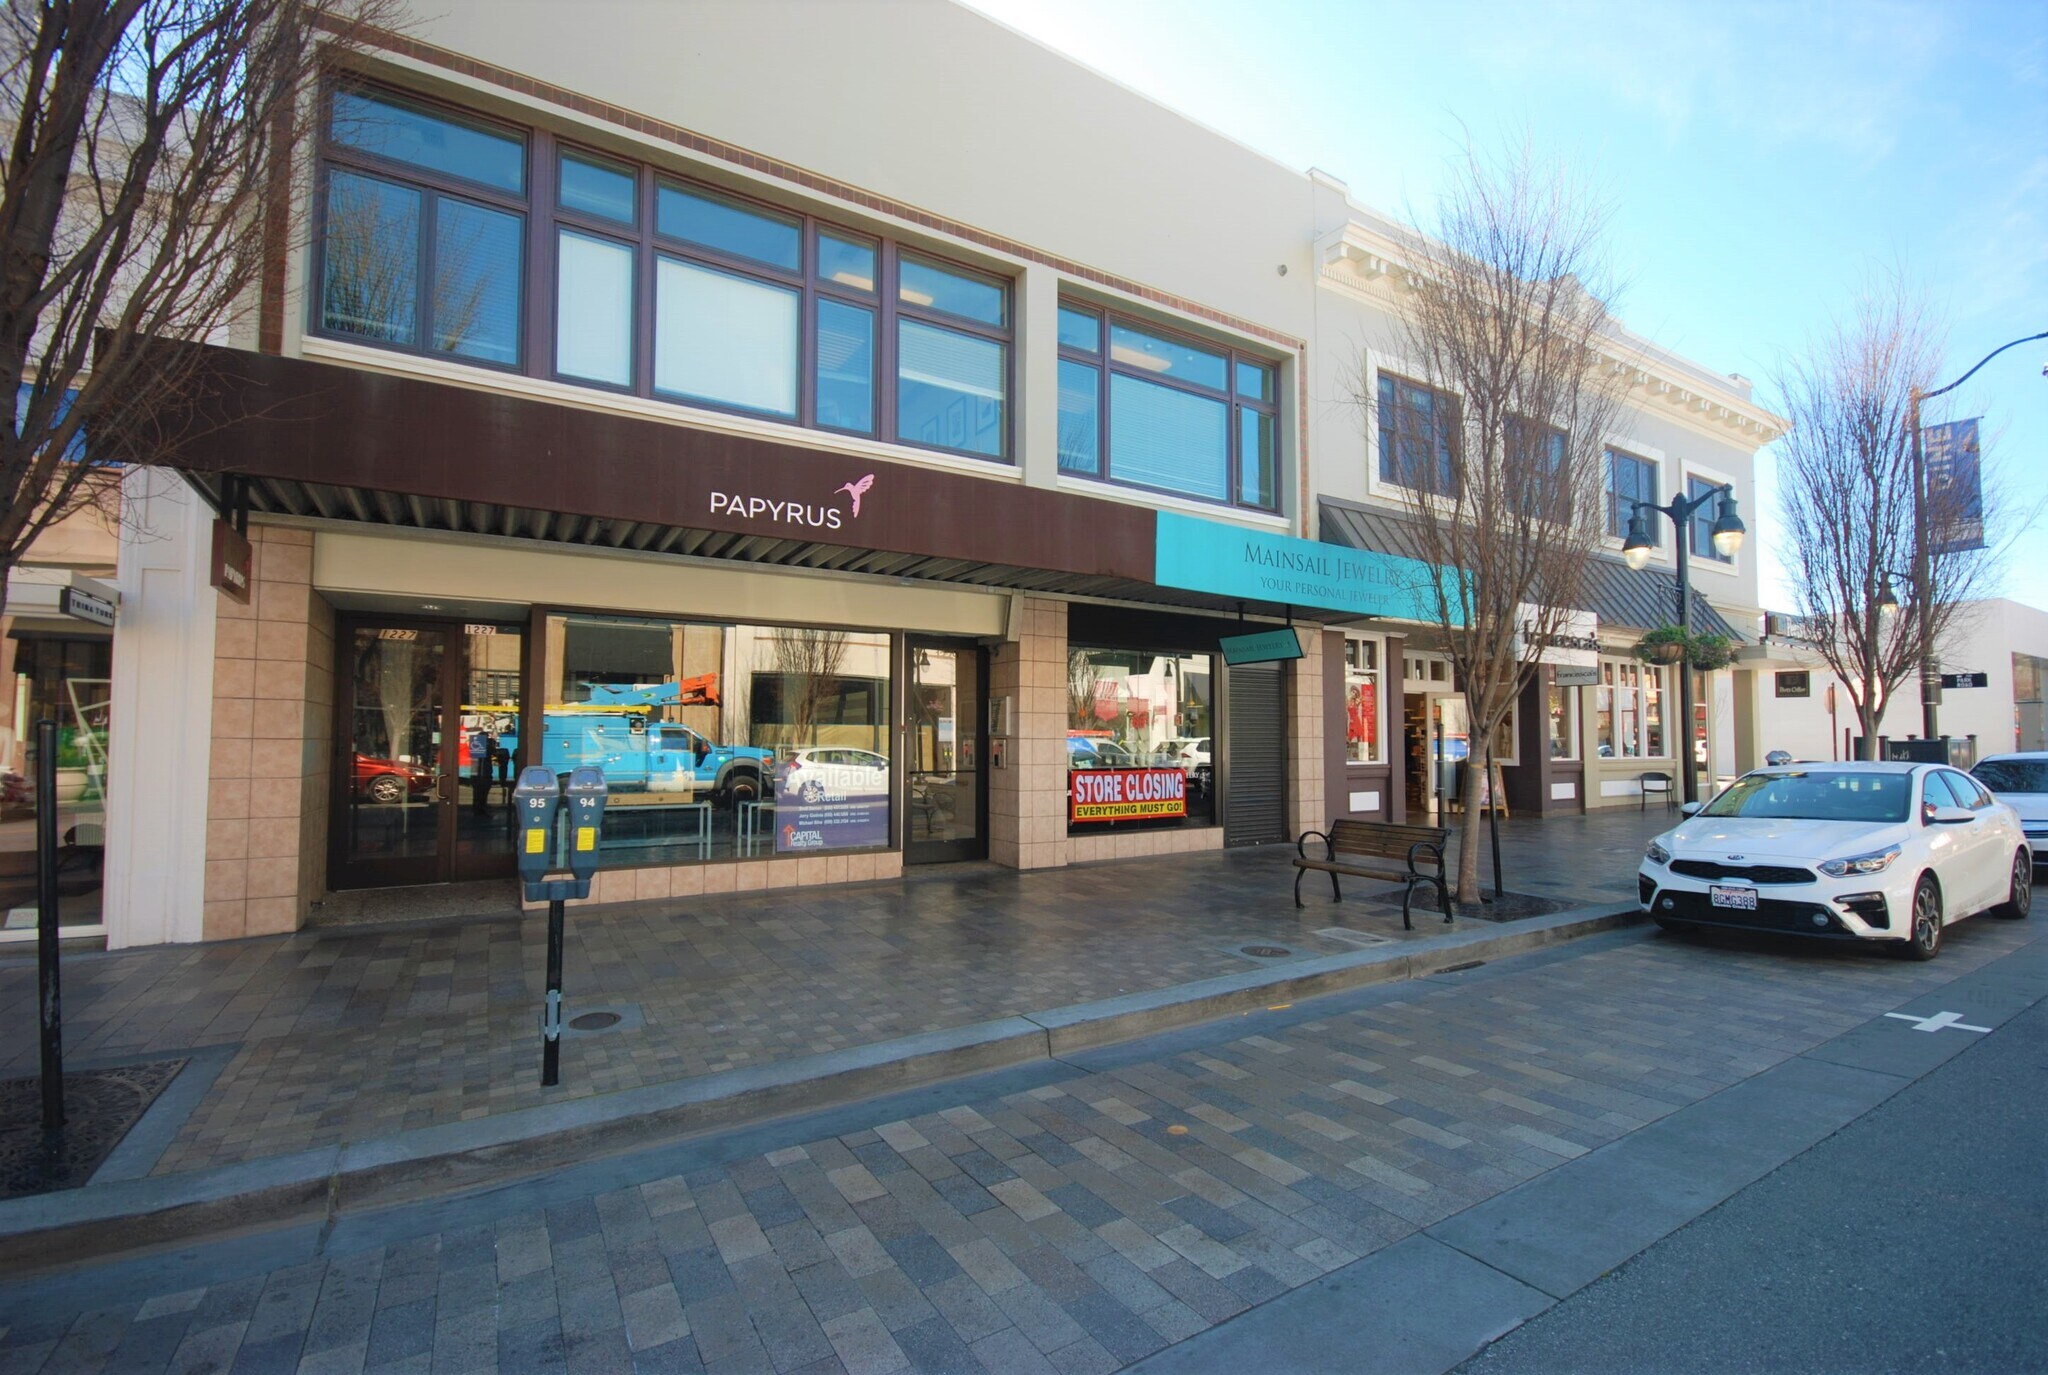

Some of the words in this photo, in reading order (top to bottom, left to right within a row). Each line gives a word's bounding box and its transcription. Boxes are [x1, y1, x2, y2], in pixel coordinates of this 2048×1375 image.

[710, 491, 841, 529] PAPYRUS
[1244, 541, 1330, 576] MAINSAIL
[1260, 576, 1293, 593] YOUR
[1295, 582, 1346, 600] PERSONAL
[380, 629, 417, 640] 1227
[466, 625, 495, 635] 1227
[787, 765, 882, 788] Available
[1075, 774, 1123, 803] STORE
[1126, 772, 1184, 801] CLOSING
[529, 797, 546, 808] 95
[579, 797, 596, 808] 94
[817, 791, 847, 802] Retail
[1076, 805, 1138, 816] EVERYTHING
[1139, 803, 1164, 814] MUST
[1167, 802, 1182, 811] GO!
[790, 830, 822, 840] CAPITAL
